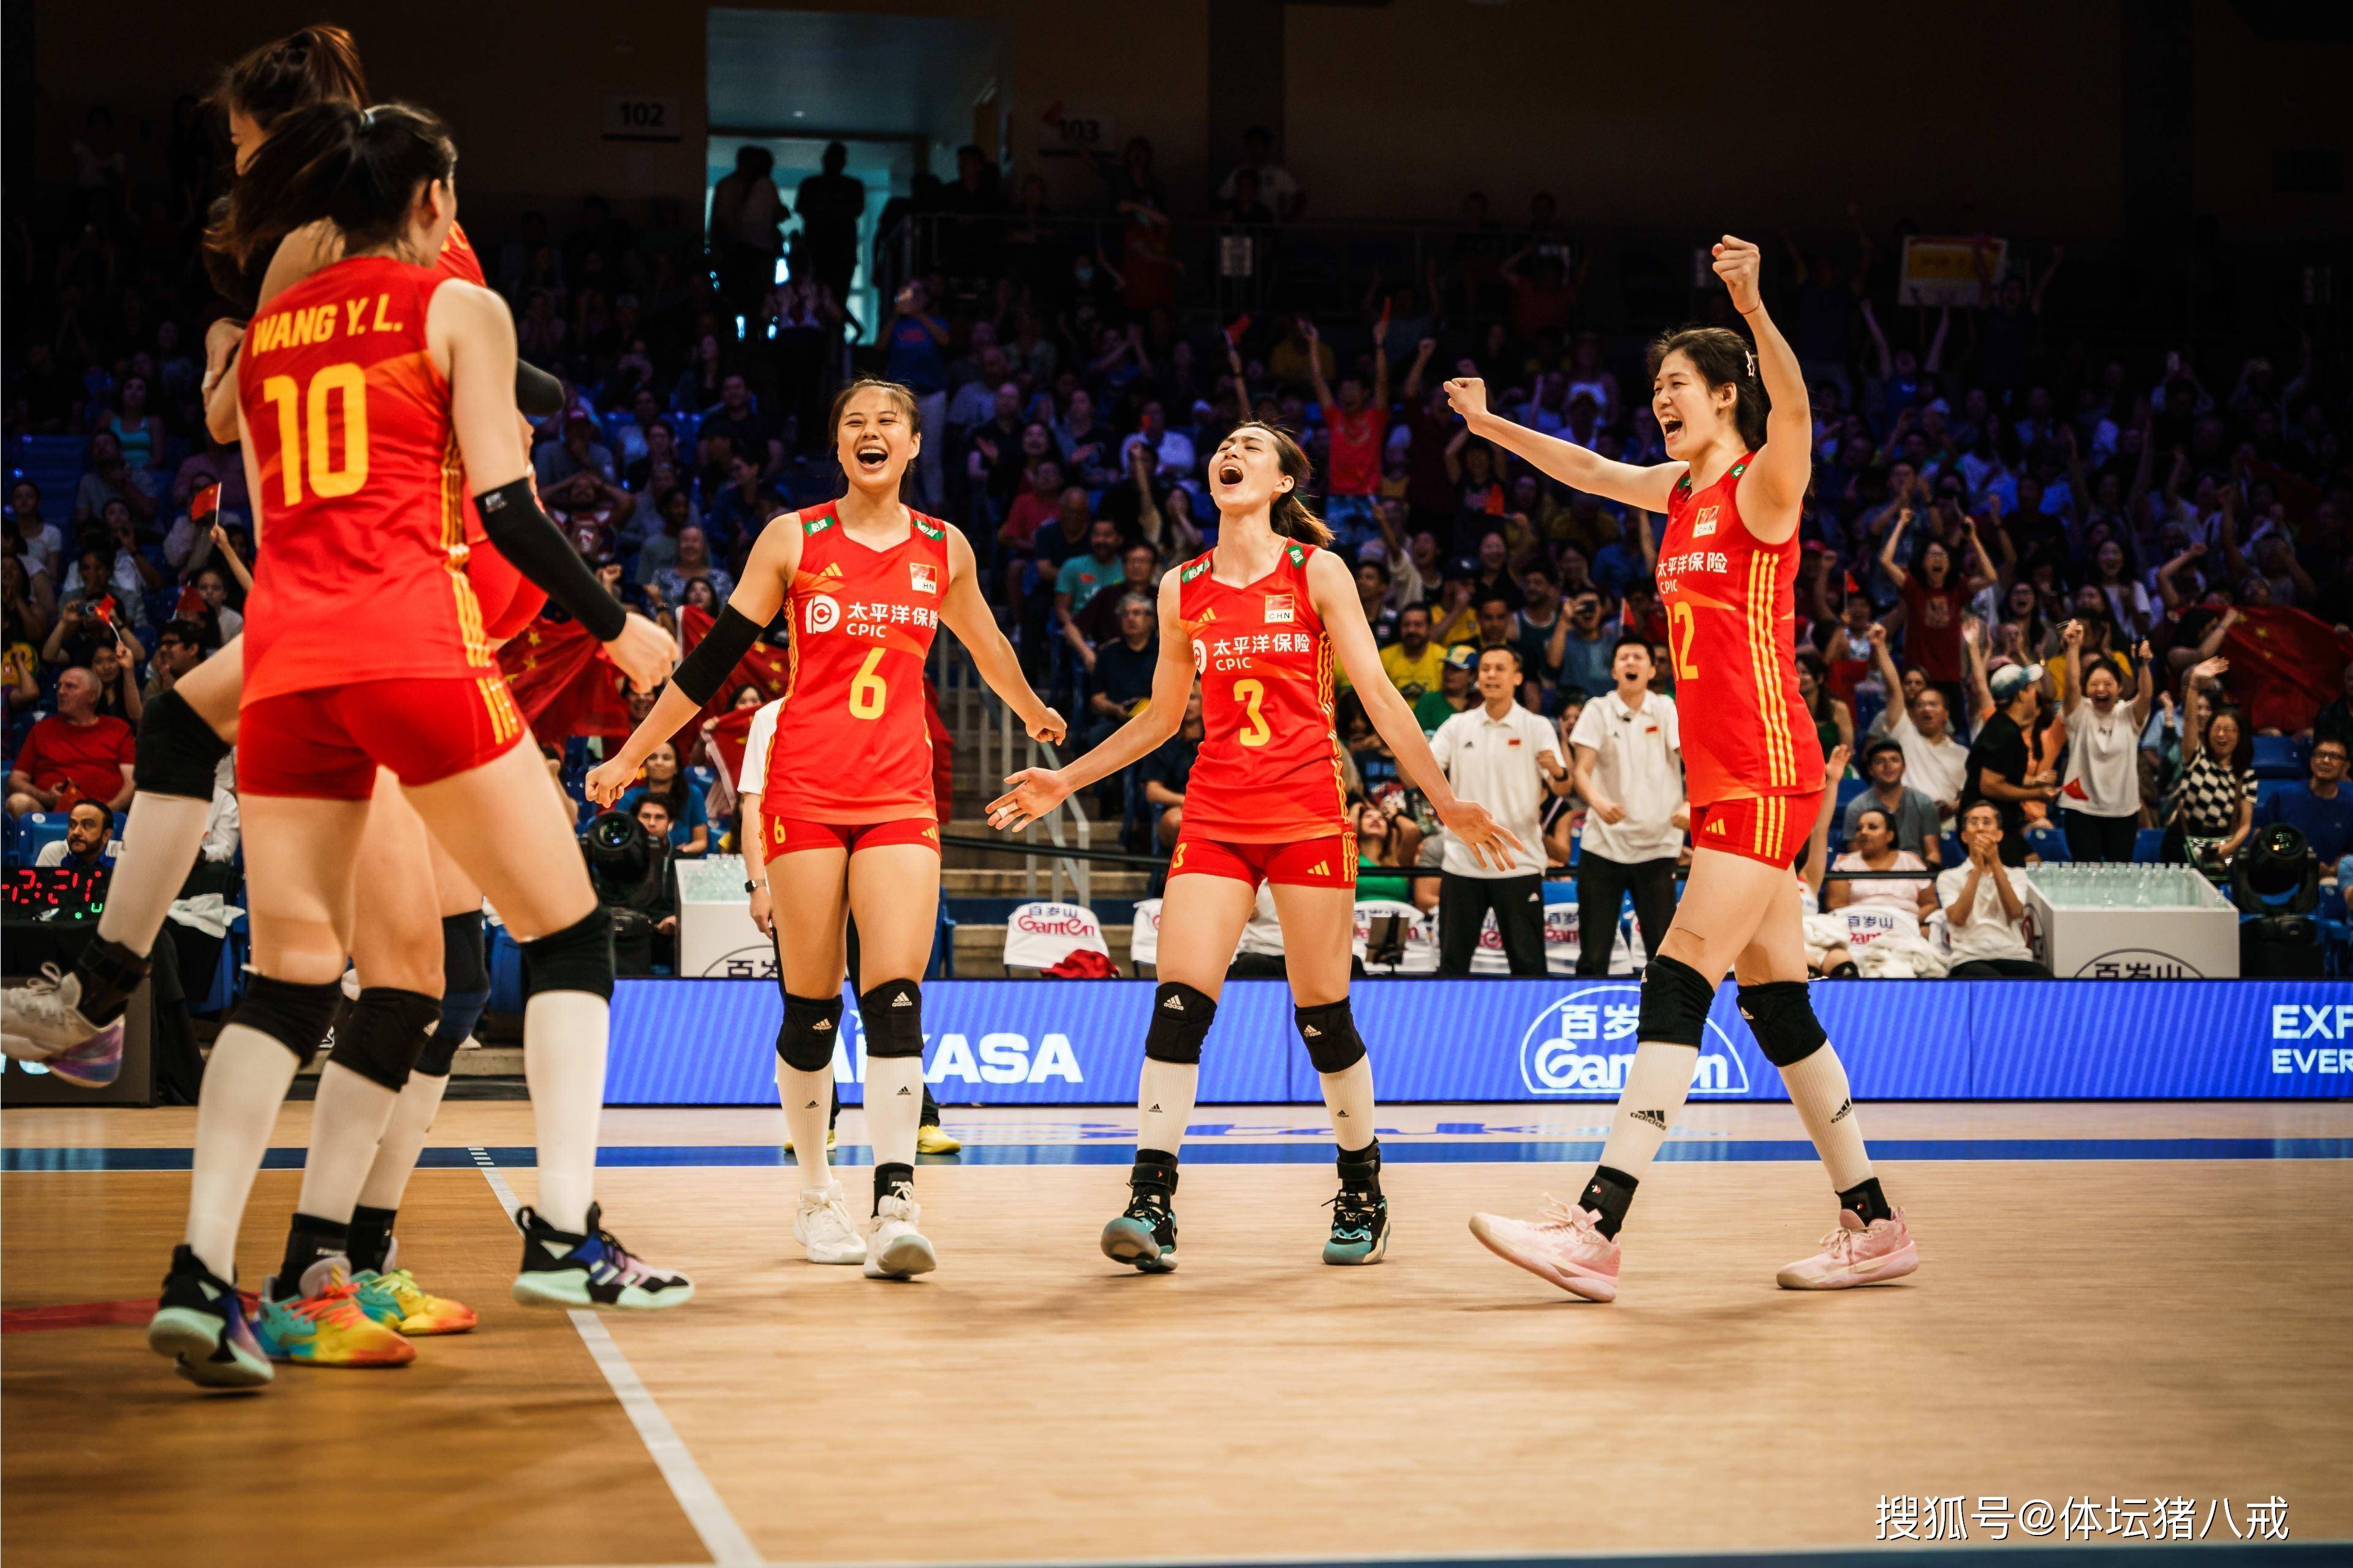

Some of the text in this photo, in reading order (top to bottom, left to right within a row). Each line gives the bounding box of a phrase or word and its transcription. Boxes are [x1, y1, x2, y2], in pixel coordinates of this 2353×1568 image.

[620, 103, 664, 126] 102
[252, 294, 404, 357] WANG Y. L.
[263, 362, 369, 507] 10
[1697, 524, 1714, 535] CHN
[1657, 551, 1728, 579] 太平洋保险
[1660, 579, 1678, 594] CPIC
[846, 623, 887, 638] CPIC
[1665, 600, 1699, 682] 12
[1213, 633, 1311, 657] 太平洋保险
[1215, 657, 1252, 672] CPIC
[849, 647, 887, 720] 6
[1233, 678, 1271, 747] 3
[774, 816, 786, 844] 6
[1173, 843, 1188, 869] 3
[1029, 906, 1077, 918] 百岁山
[1847, 915, 1893, 930] 百岁山
[1560, 1004, 1640, 1041] 百岁
[1630, 1112, 1667, 1131] adidas
